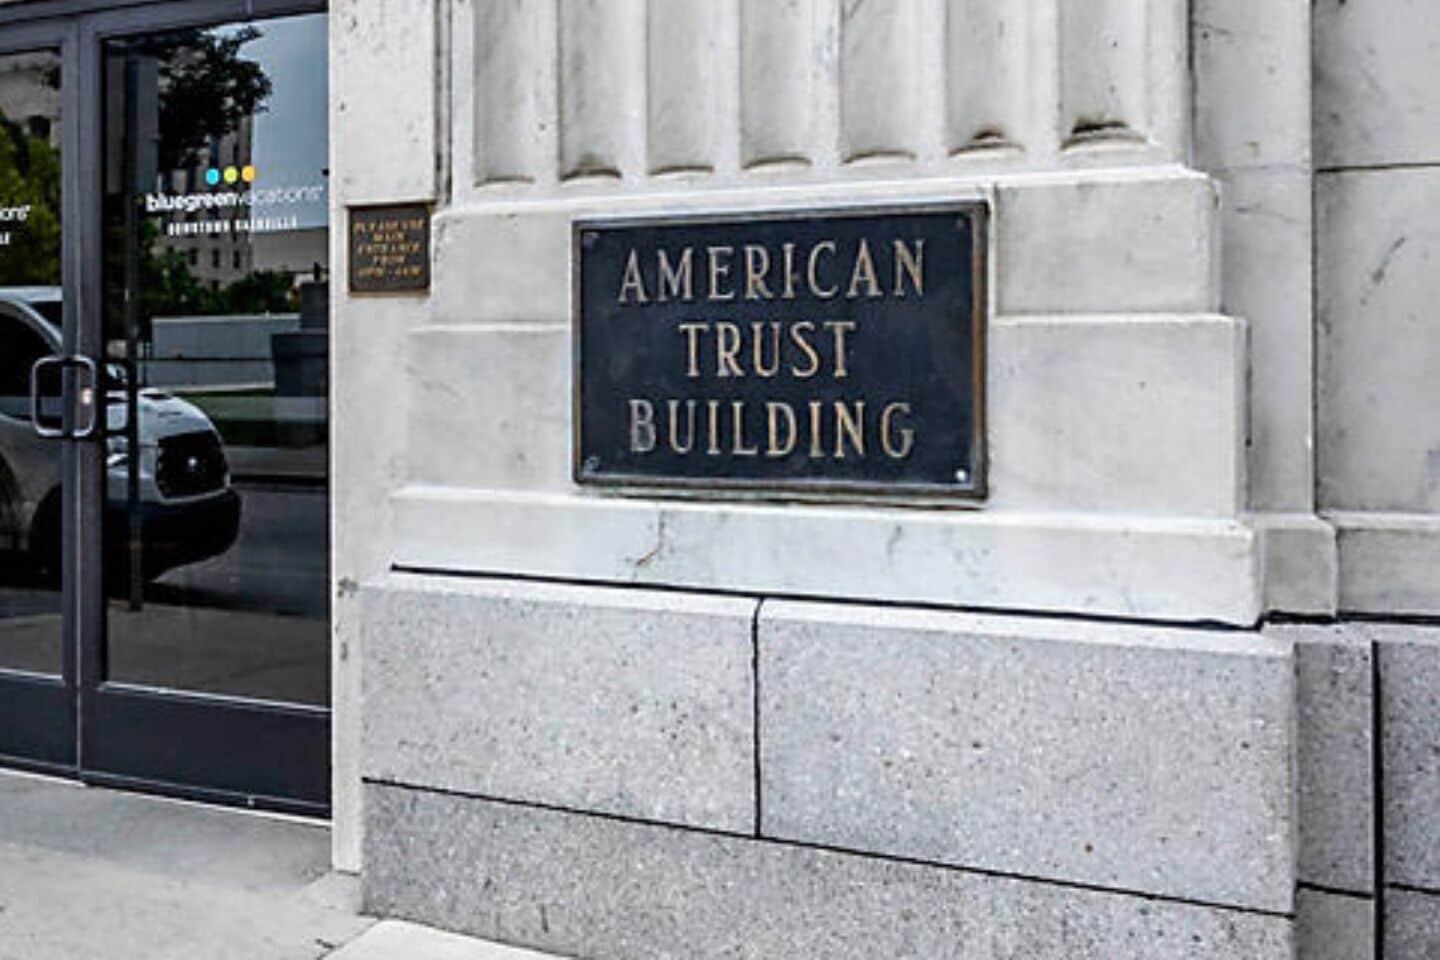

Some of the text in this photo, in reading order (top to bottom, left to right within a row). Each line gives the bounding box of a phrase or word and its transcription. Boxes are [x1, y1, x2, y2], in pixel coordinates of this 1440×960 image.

[617, 238, 926, 303] AMERICAN
[678, 320, 857, 379] TRUST
[628, 399, 916, 460] BUILDING
